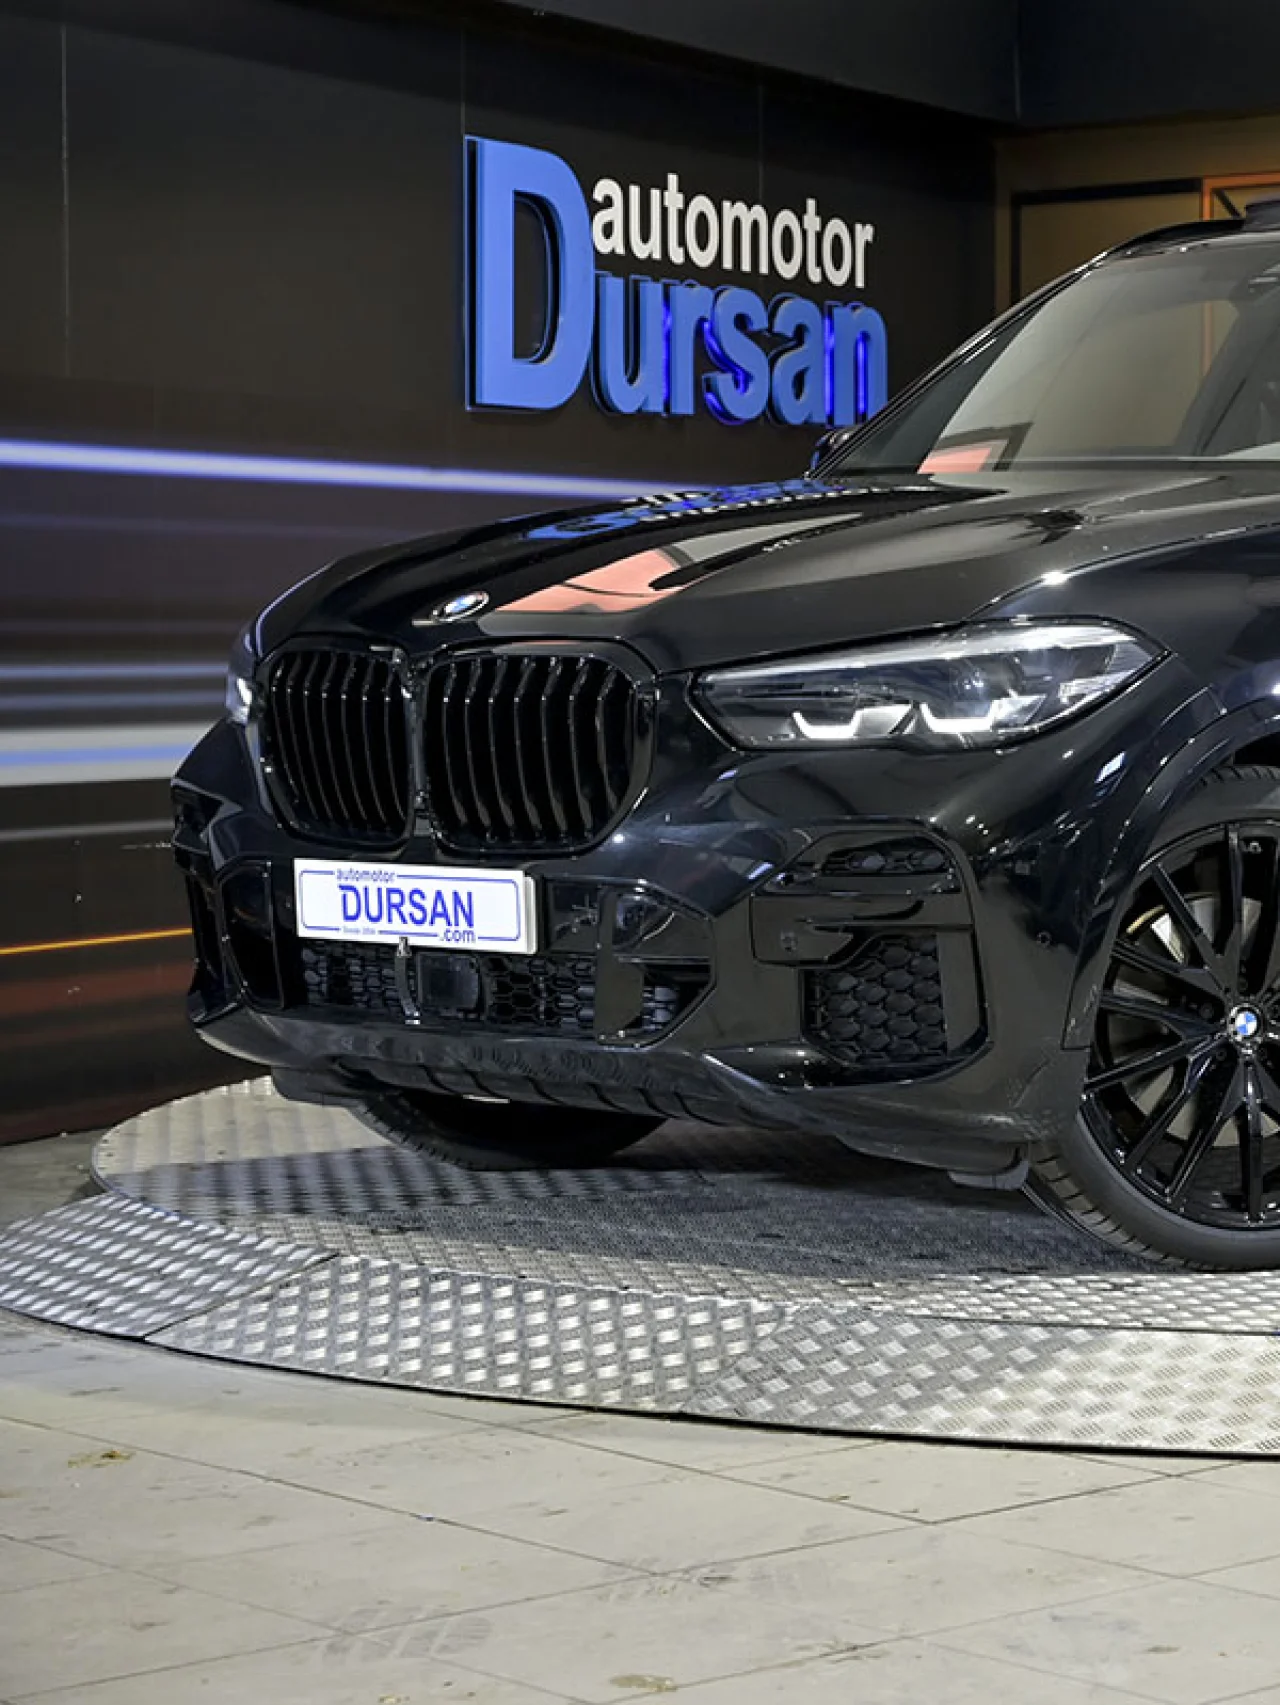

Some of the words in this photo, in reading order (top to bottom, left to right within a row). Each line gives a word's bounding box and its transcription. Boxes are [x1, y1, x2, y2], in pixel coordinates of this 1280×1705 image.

[591, 172, 874, 288] automotor
[464, 135, 889, 427] Dursan
[338, 884, 475, 928] DURSAN
[440, 929, 476, 944] .com
